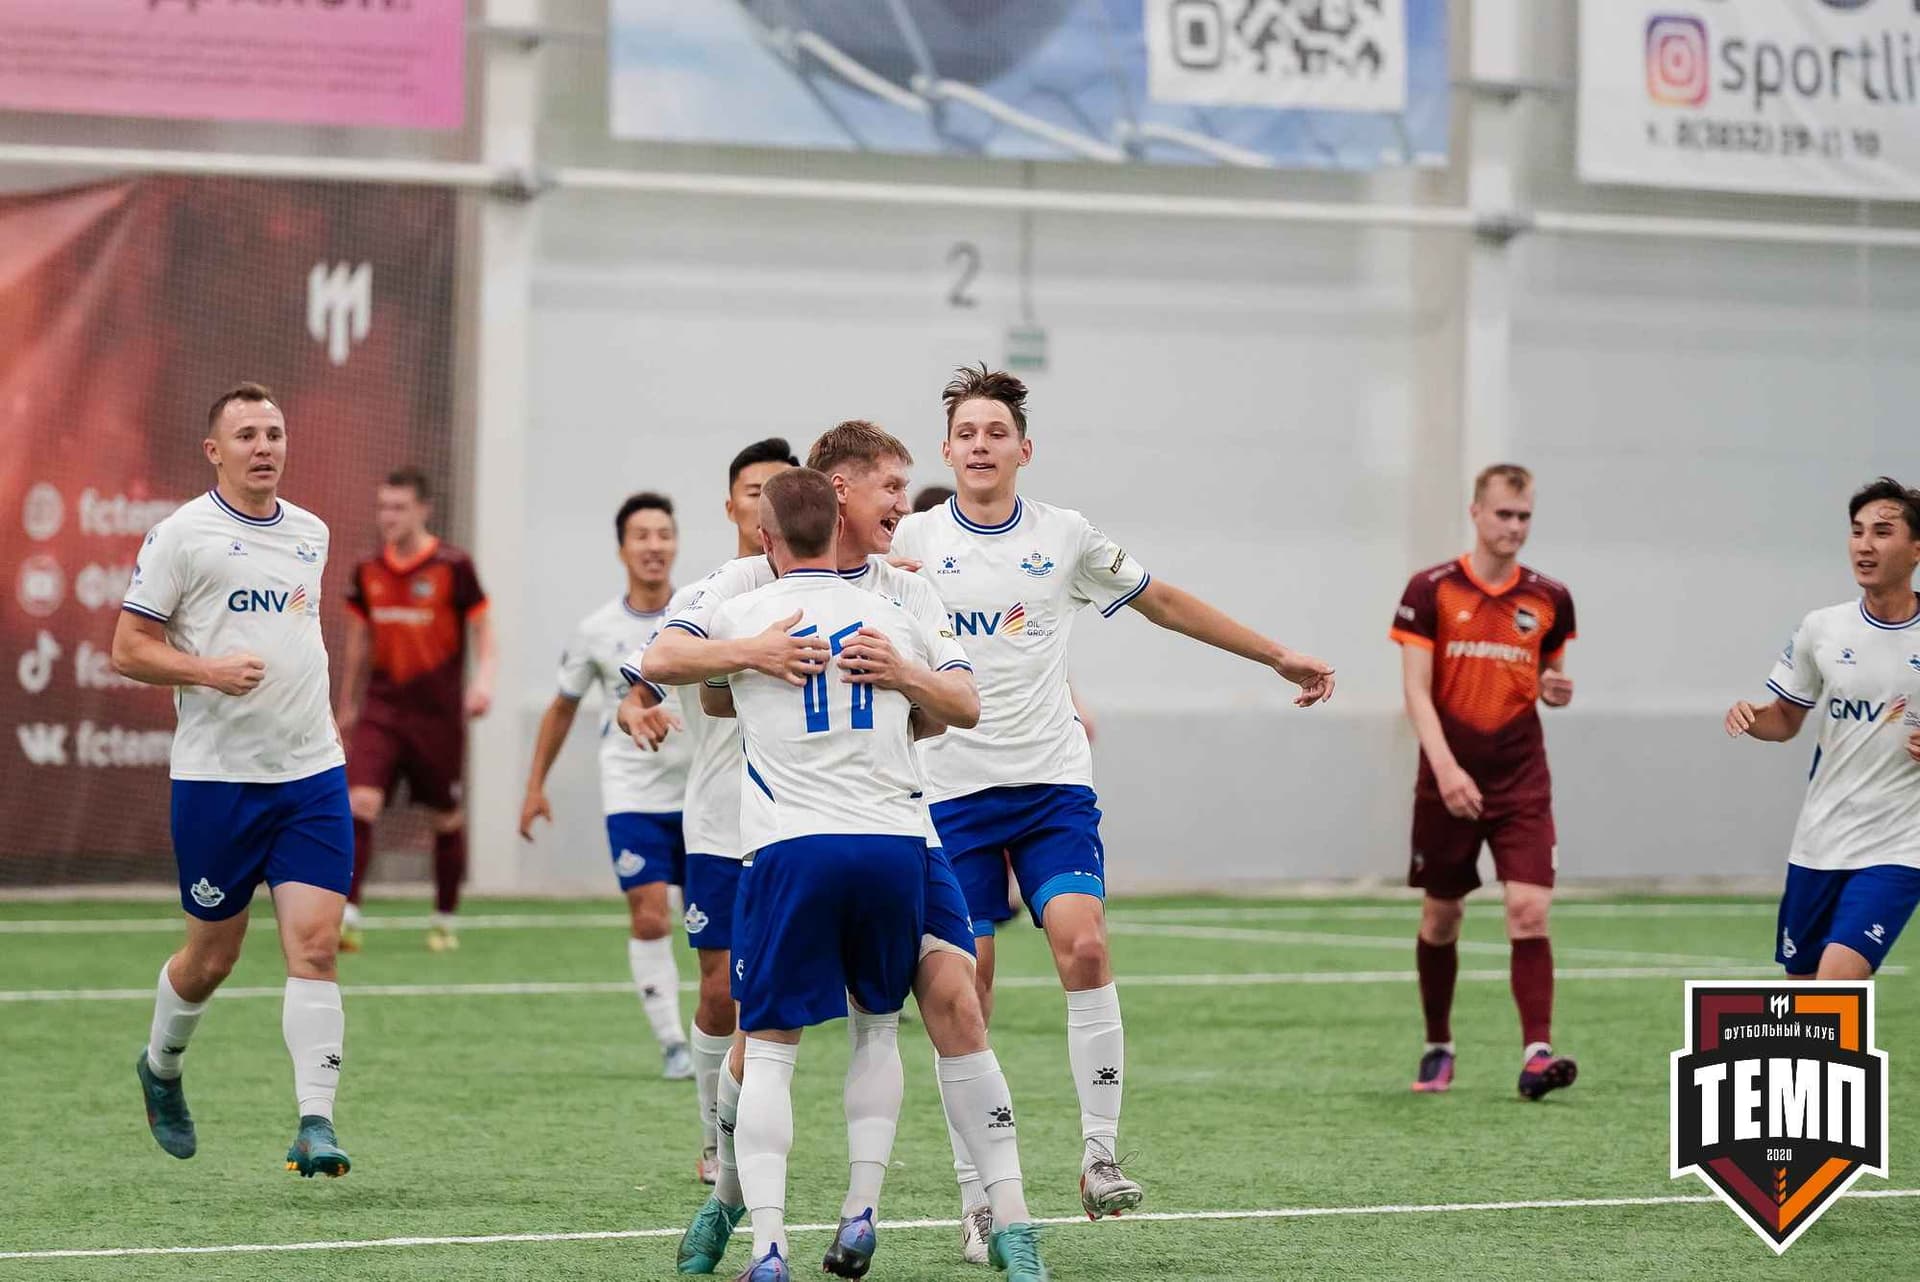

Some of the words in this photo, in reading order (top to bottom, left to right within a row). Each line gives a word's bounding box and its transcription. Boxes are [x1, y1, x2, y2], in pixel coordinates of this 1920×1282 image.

[945, 241, 981, 308] 2
[227, 589, 289, 613] GNV
[947, 610, 1002, 637] NV
[1026, 619, 1042, 629] OIL
[1829, 696, 1886, 722] GNV
